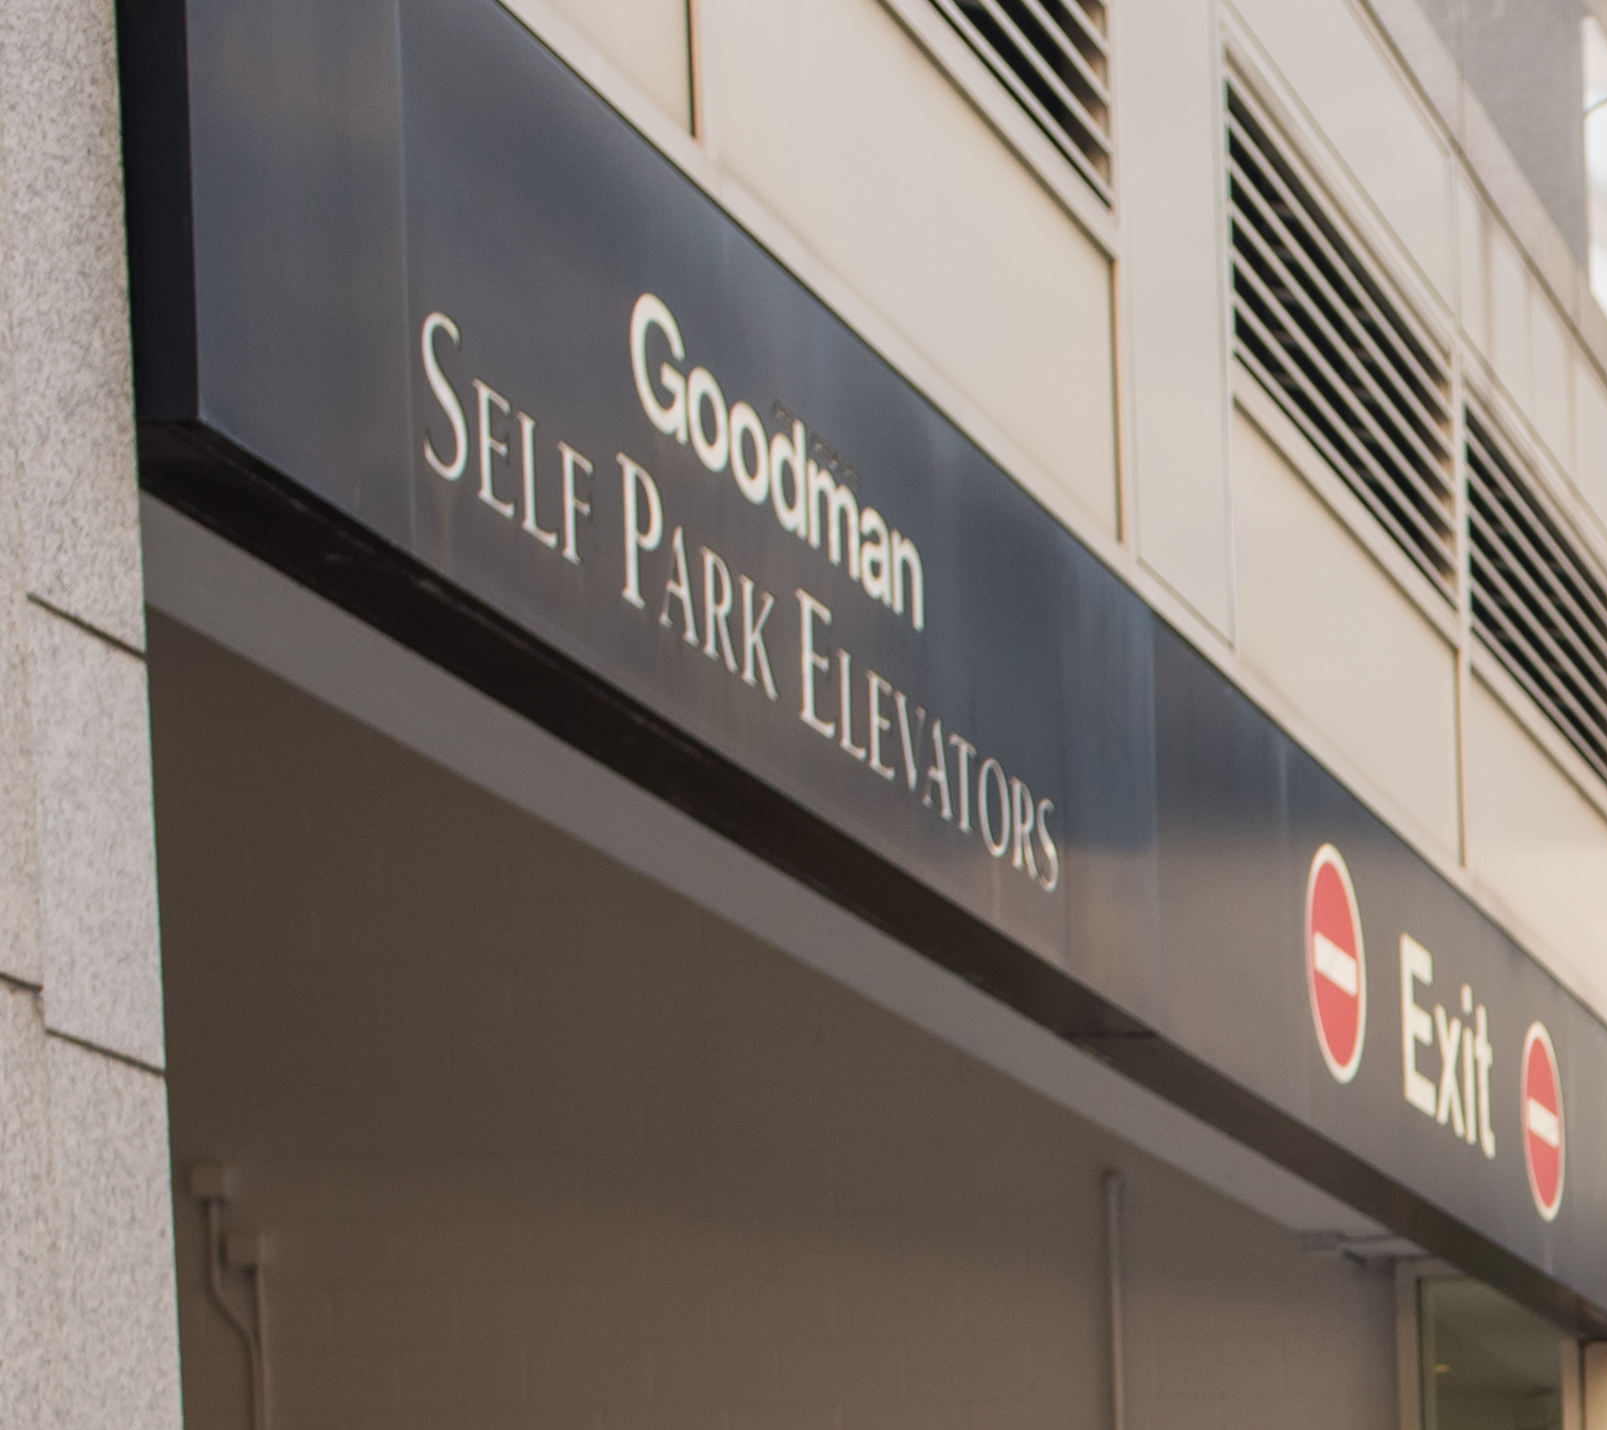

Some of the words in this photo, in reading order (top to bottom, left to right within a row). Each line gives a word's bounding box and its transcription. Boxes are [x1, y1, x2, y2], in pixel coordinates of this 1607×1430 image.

[420, 311, 593, 566] SELF
[616, 451, 779, 704] PARK
[798, 588, 1060, 895] ELEVATORS
[629, 292, 926, 632] Goodman
[1398, 932, 1497, 1161] Exit
